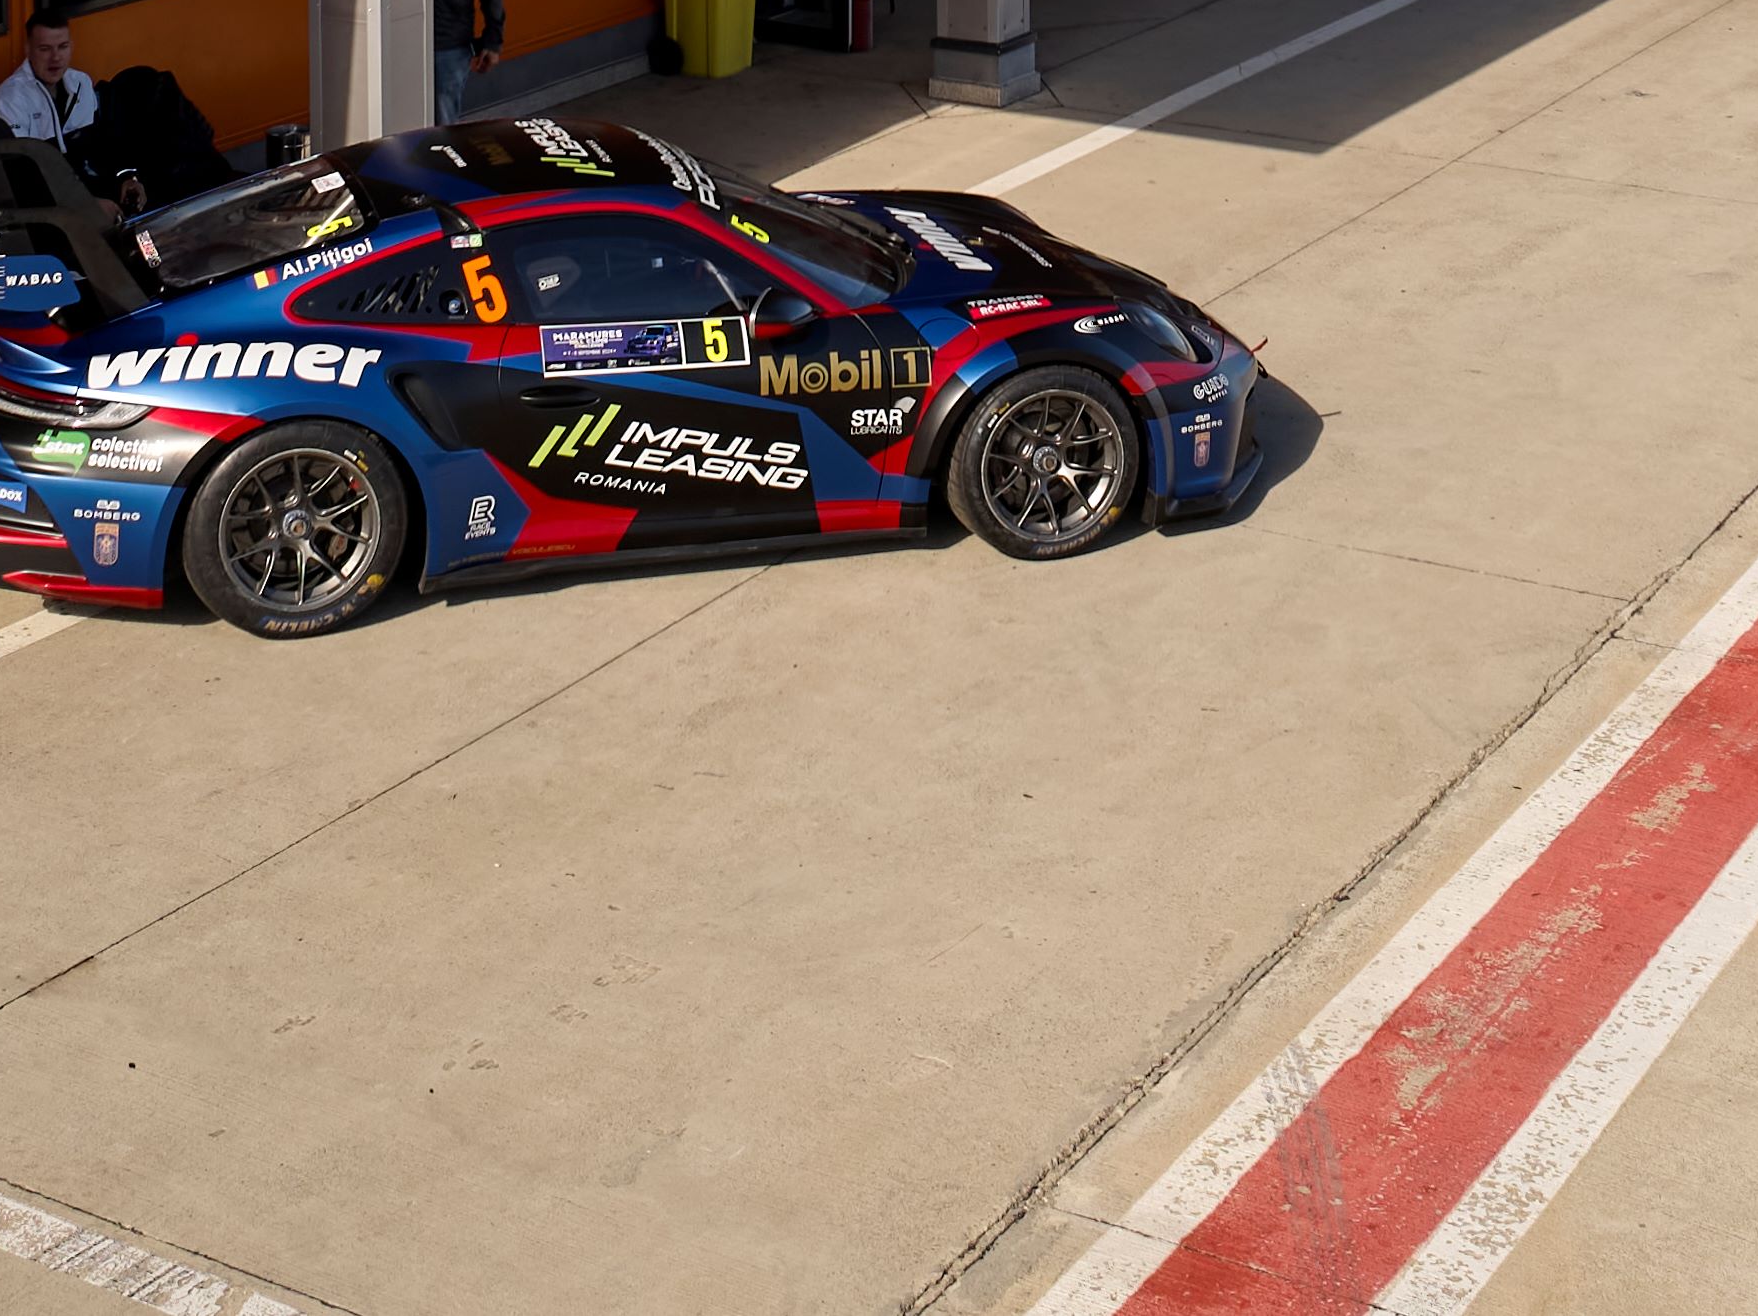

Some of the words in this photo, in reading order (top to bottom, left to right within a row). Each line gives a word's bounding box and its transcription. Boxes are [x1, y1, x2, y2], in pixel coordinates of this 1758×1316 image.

[731, 214, 770, 244] 5
[5, 272, 63, 287] WABAG
[462, 254, 508, 323] 5
[702, 318, 729, 363] 5
[87, 332, 382, 390] winner
[759, 348, 882, 396] Mobil
[902, 352, 917, 383] 1
[1193, 373, 1230, 400] GUIDO
[851, 409, 903, 427] STAR
[1180, 419, 1223, 434] BOMBERG
[620, 421, 801, 465] IMPULS
[88, 452, 164, 473] selective!
[604, 444, 809, 490] LEASING
[573, 471, 668, 495] ROMANIA
[73, 509, 141, 521] BOMBERG
[264, 603, 357, 633] MCHELIN
